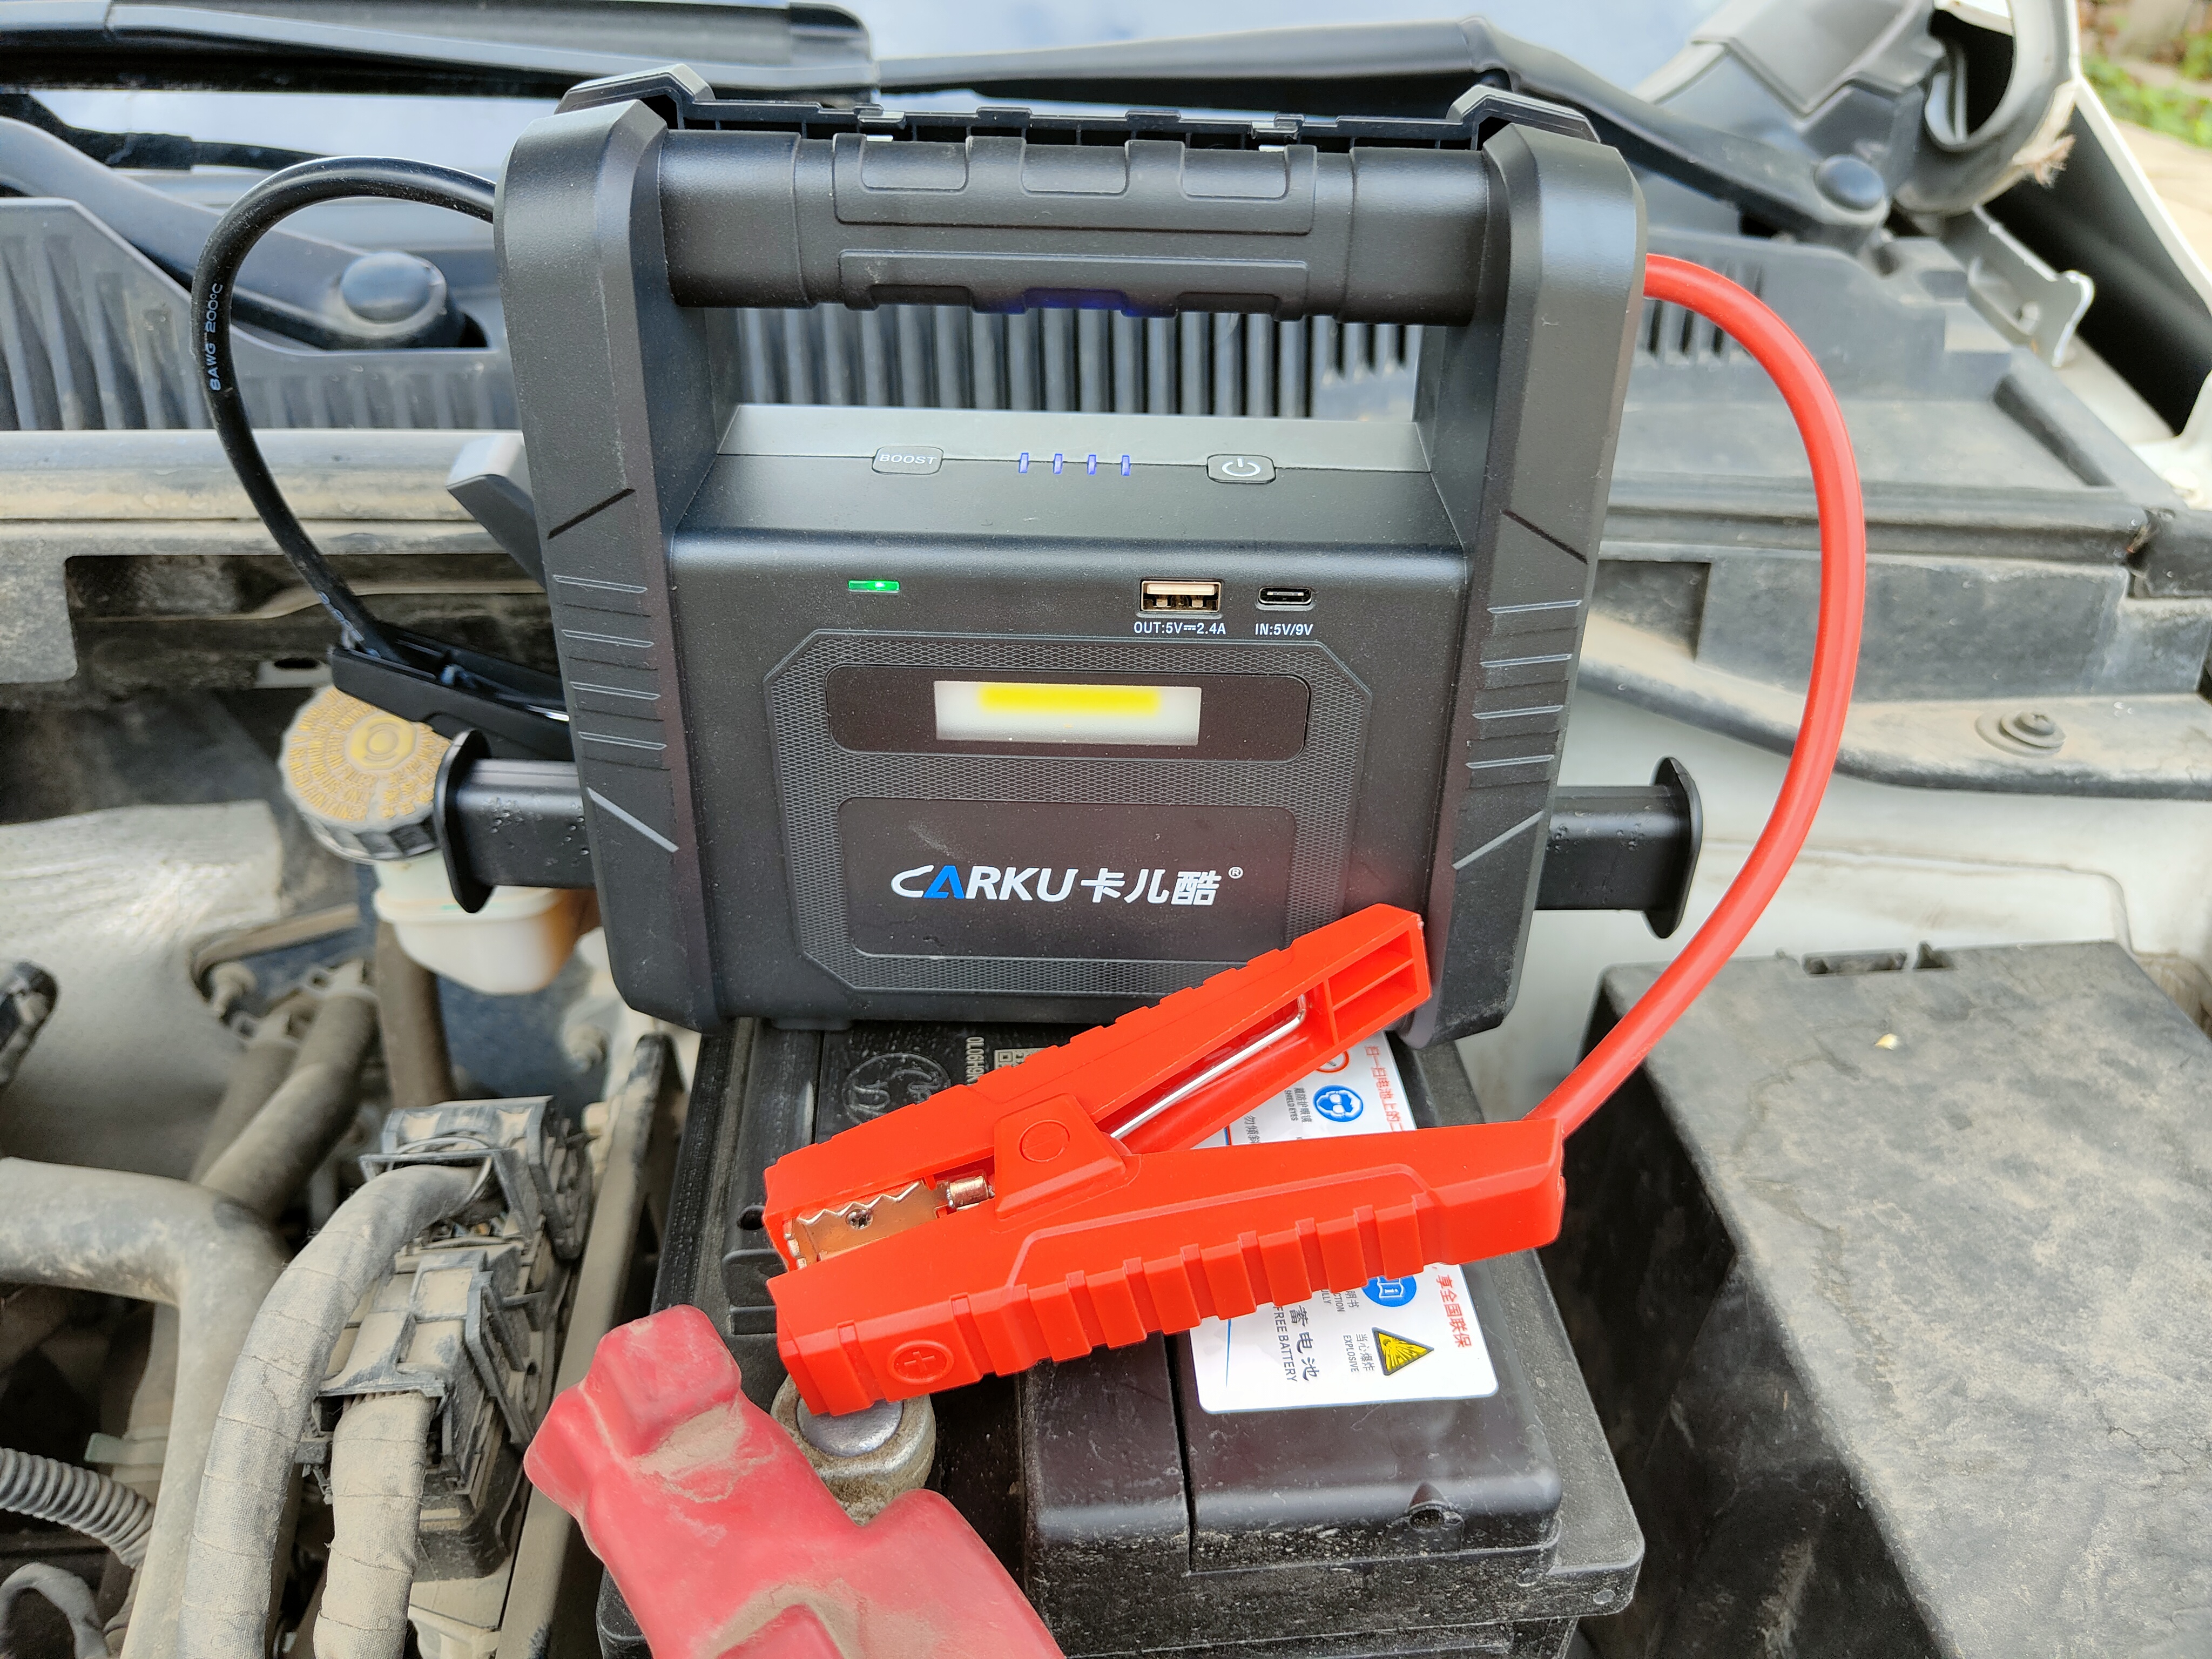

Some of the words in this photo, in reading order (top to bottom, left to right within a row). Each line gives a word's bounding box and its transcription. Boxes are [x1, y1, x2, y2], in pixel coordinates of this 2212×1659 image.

[879, 454, 938, 464] BOOST
[1255, 623, 1313, 636] IN:5V/9V
[891, 865, 1078, 902] CARKU
[1285, 1090, 1296, 1109] SHIELD
[1290, 1108, 1298, 1121] EYES
[1278, 1334, 1298, 1382] BATTERY
[1343, 1334, 1359, 1372] EXPLOSIVE
[1355, 1333, 1374, 1371] 当心爆炸
